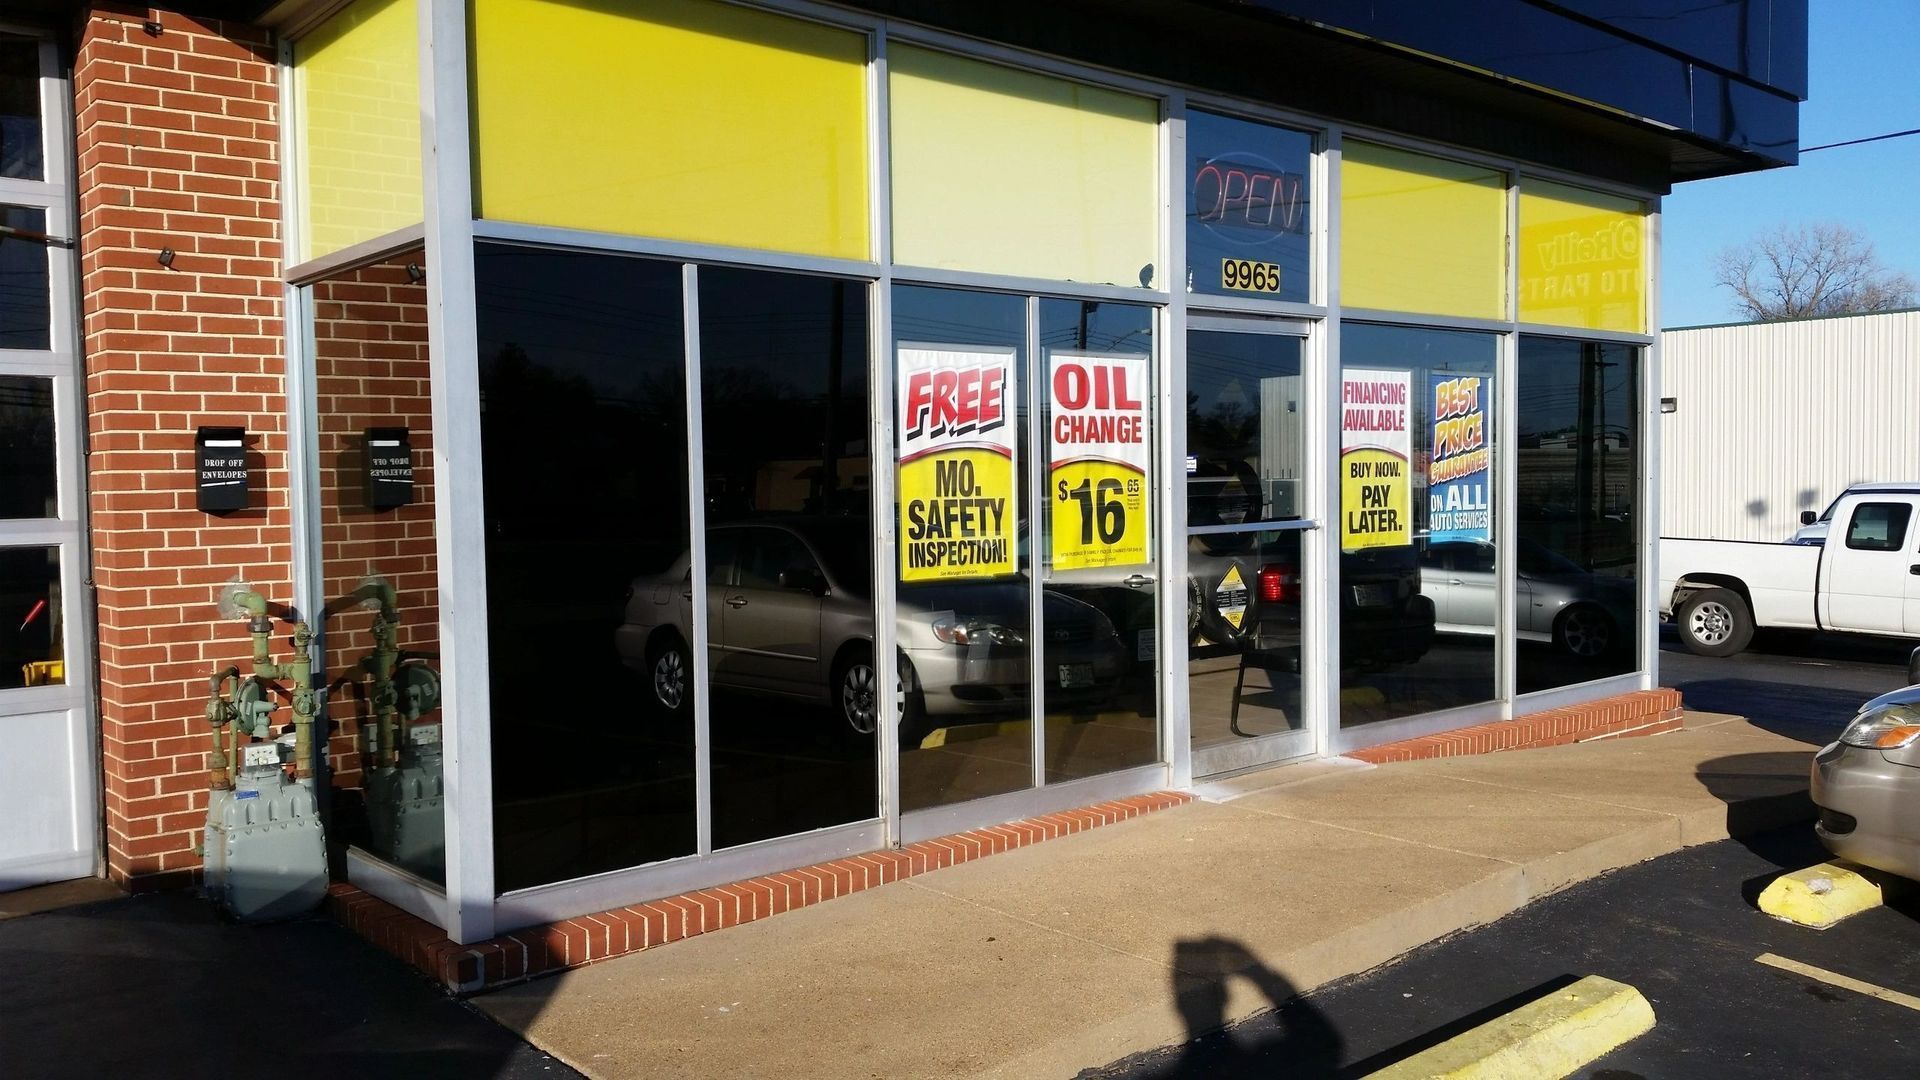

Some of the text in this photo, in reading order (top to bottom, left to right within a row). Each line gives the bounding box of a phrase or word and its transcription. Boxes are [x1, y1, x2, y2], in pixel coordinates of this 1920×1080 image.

[1196, 166, 1298, 228] OPEN
[1224, 259, 1280, 291] 9965
[1053, 363, 1143, 411] OIL
[1343, 381, 1406, 404] FINANCING
[1436, 377, 1480, 420] BEST
[906, 365, 1006, 440] FREE
[1054, 414, 1142, 444] CHANGE
[1343, 409, 1404, 431] AVAILABLE
[1434, 411, 1482, 460] PRICE
[202, 470, 247, 479] ENVELOPES
[205, 458, 244, 467] DROP OFF
[1350, 461, 1401, 478] BUY NOW.
[936, 459, 982, 497] MO.
[1127, 479, 1140, 492] 65
[1361, 485, 1391, 508] PAY
[1431, 485, 1487, 513] ON ALL
[908, 498, 1005, 540] SAFETY
[1348, 509, 1403, 534] LATER.
[1430, 511, 1488, 531] AUTO SERVICES
[908, 539, 1007, 569] INSPECTION!
